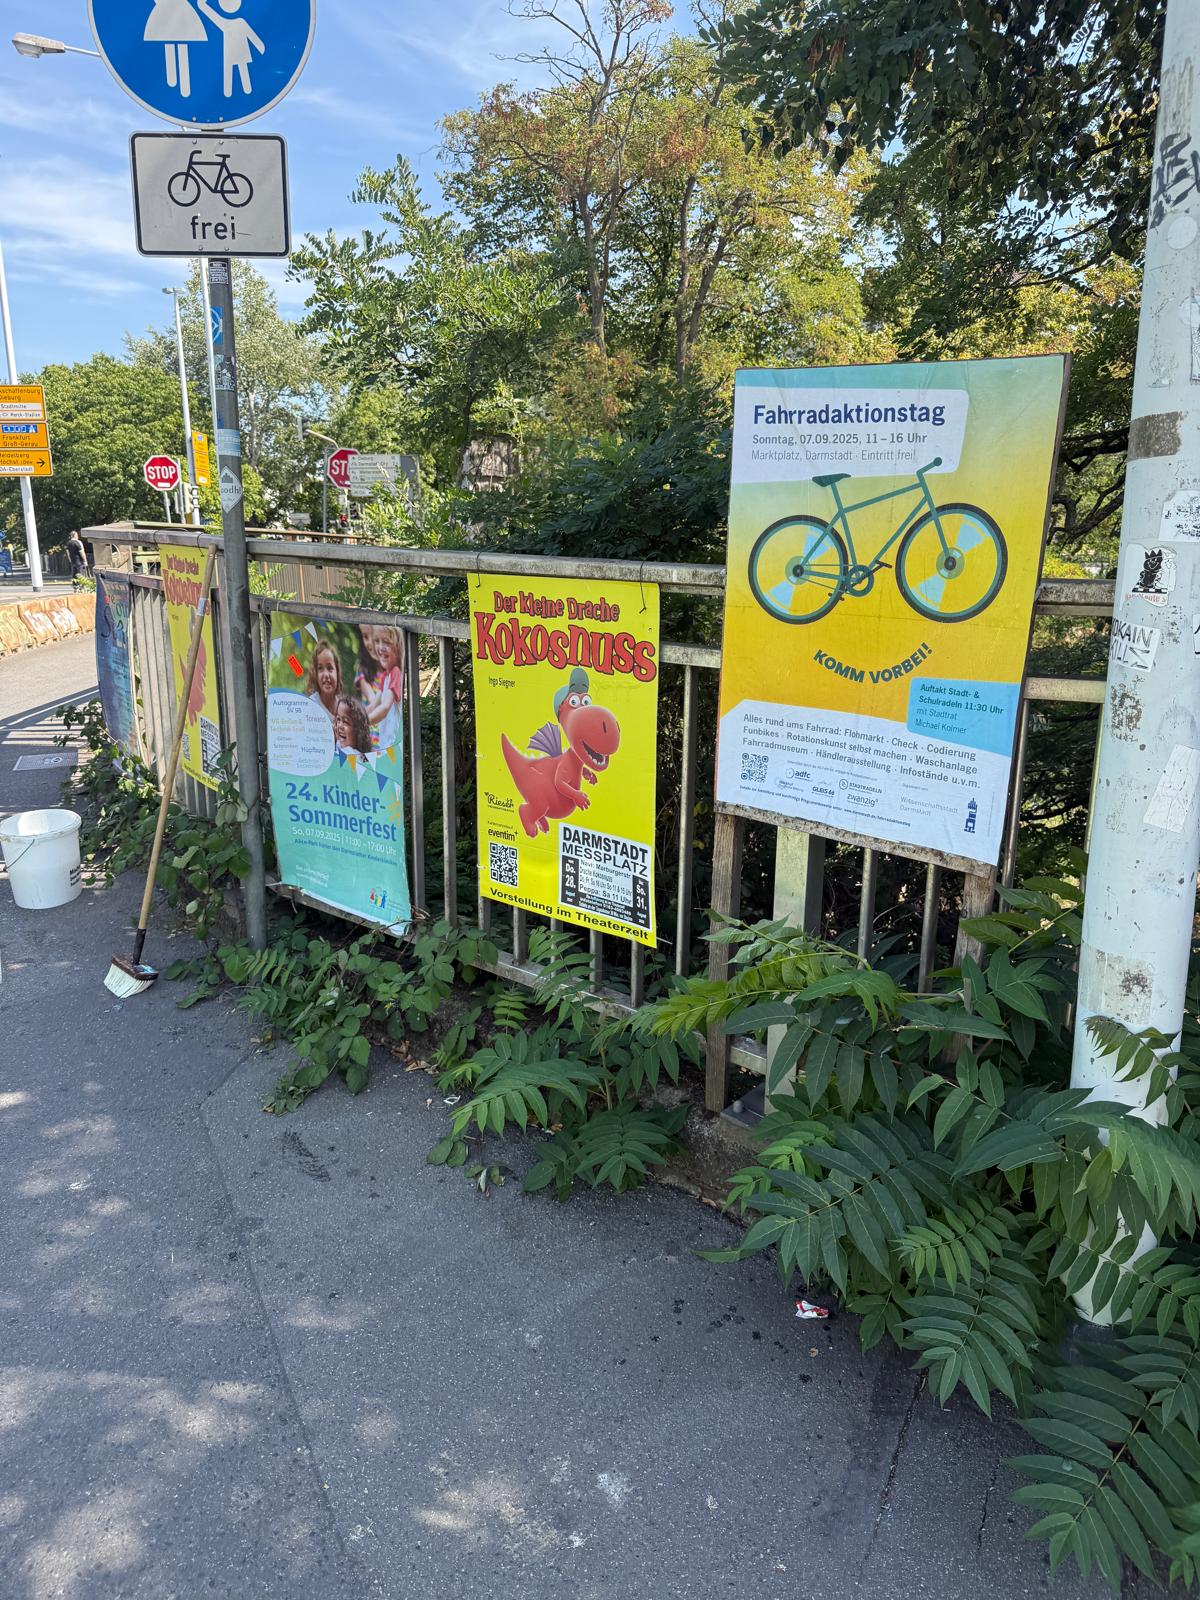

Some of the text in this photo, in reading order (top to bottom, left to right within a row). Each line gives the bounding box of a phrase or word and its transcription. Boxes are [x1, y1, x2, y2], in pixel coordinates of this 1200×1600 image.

[190, 215, 236, 240] frei
[753, 403, 946, 426] Fahrradaktionstag
[752, 434, 798, 446] Sonntag,
[800, 433, 862, 446] 07.09.2025,
[907, 433, 928, 444] Uhr
[751, 449, 917, 463] Marktplatz, Darmstadt Eintritt frei!
[148, 466, 176, 480] STOP
[493, 590, 621, 622] Der kleine Drache
[813, 642, 933, 684] KOMM VORBEI!
[488, 676, 516, 689] Ingo Siegner
[920, 683, 980, 699] Auftakt Stadt- &
[916, 707, 958, 720] mit Stadtrat
[918, 695, 1005, 715] Schulradeln 11:30 Uhr
[915, 718, 968, 735] Michael Kolmer
[743, 713, 977, 761] Alles rund ums Fahrrad: Flohmarkt Check Codierung
[743, 726, 978, 774] Funbikes Rotationskunst selbst machen Waschanlage
[742, 737, 808, 755] Fahrradmuseum
[815, 749, 892, 773] Händlerausstellung
[900, 765, 949, 782] Infostände
[951, 776, 981, 789] u.v.m.
[795, 769, 812, 779] adfc
[285, 782, 386, 813] 24. Kinder-
[812, 786, 828, 794] GLEIS
[899, 804, 931, 817] Darmstadt
[900, 796, 959, 814] Wissenschaftsstadt
[288, 804, 398, 842] Sommerfest
[292, 826, 305, 837] So,
[305, 829, 341, 842] 07.09.2025
[345, 836, 361, 848] 11:00
[368, 841, 384, 853] 17:00
[385, 845, 397, 856] Uhr
[488, 828, 516, 841] eventim
[563, 826, 648, 863] DARMSTADT
[562, 842, 648, 877] MESSPLATZ
[580, 860, 632, 879] Navi: Marburgerstr.
[565, 875, 576, 889] 28.
[636, 884, 646, 896] So.
[580, 883, 601, 896] Peppa:
[602, 890, 611, 898] Sa
[612, 893, 619, 901] 11
[636, 896, 647, 911] 31.
[490, 887, 553, 914] Vorstellung
[556, 906, 572, 919] im
[575, 911, 649, 940] Theaterzelt
